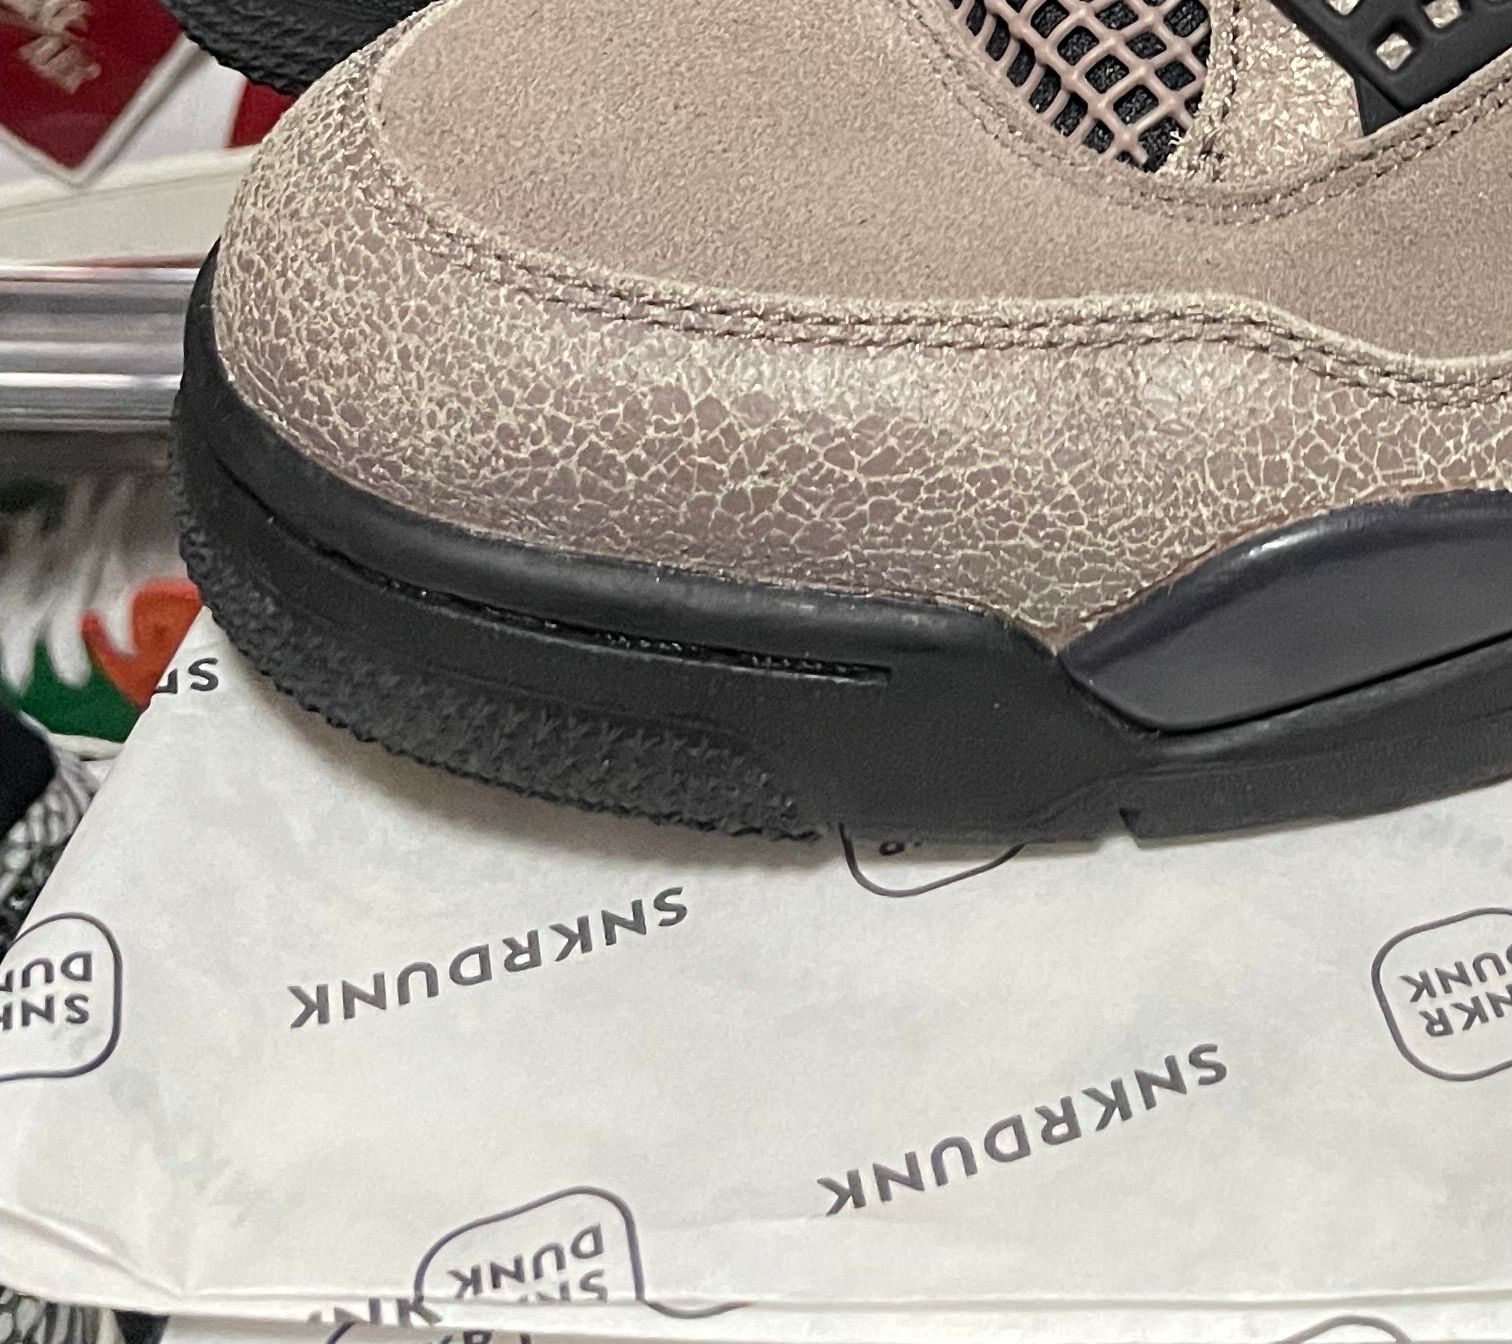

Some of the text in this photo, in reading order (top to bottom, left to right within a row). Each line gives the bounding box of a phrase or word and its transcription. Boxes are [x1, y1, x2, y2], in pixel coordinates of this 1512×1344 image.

[288, 887, 687, 1029] SNKRDUNK
[817, 1044, 1227, 1216] SNKRDUNK
[447, 1223, 604, 1299] DUNK
